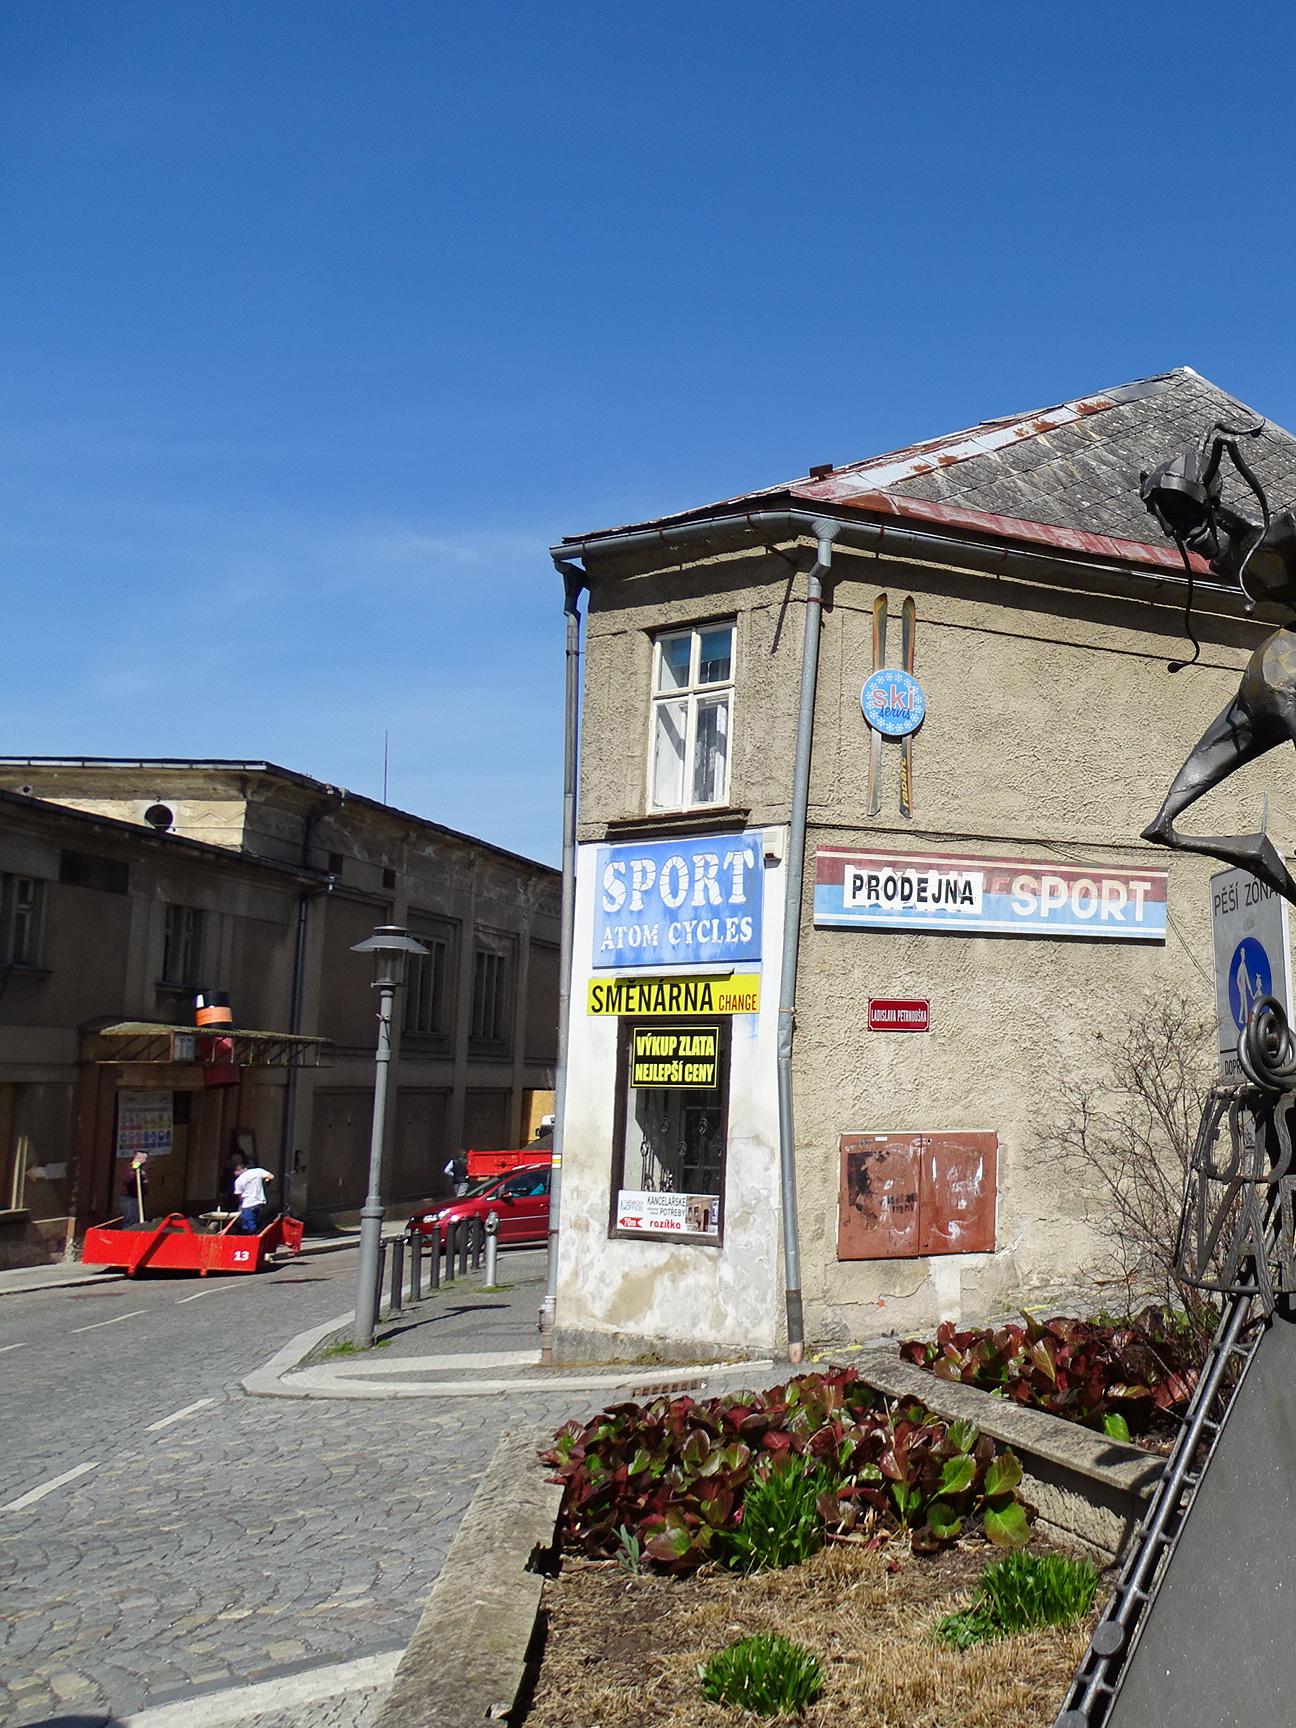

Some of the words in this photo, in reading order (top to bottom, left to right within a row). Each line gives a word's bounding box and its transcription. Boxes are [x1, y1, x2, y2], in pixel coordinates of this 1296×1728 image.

[602, 849, 755, 913] SPORT
[852, 873, 975, 905] PRODEJNA
[1011, 875, 1151, 922] SPORT
[1214, 881, 1240, 917] PĚŠÍ
[600, 924, 659, 951] ATOM
[667, 917, 753, 945] CYCLES
[591, 979, 714, 1013] SMĚNÁRNA
[718, 994, 758, 1012] CHANGE
[636, 1033, 677, 1057] VÝKUP
[678, 1035, 715, 1057] ZLATA
[635, 1060, 684, 1083] NEJLEPŠÍ
[684, 1063, 715, 1083] CENY
[232, 1250, 250, 1262] 13
